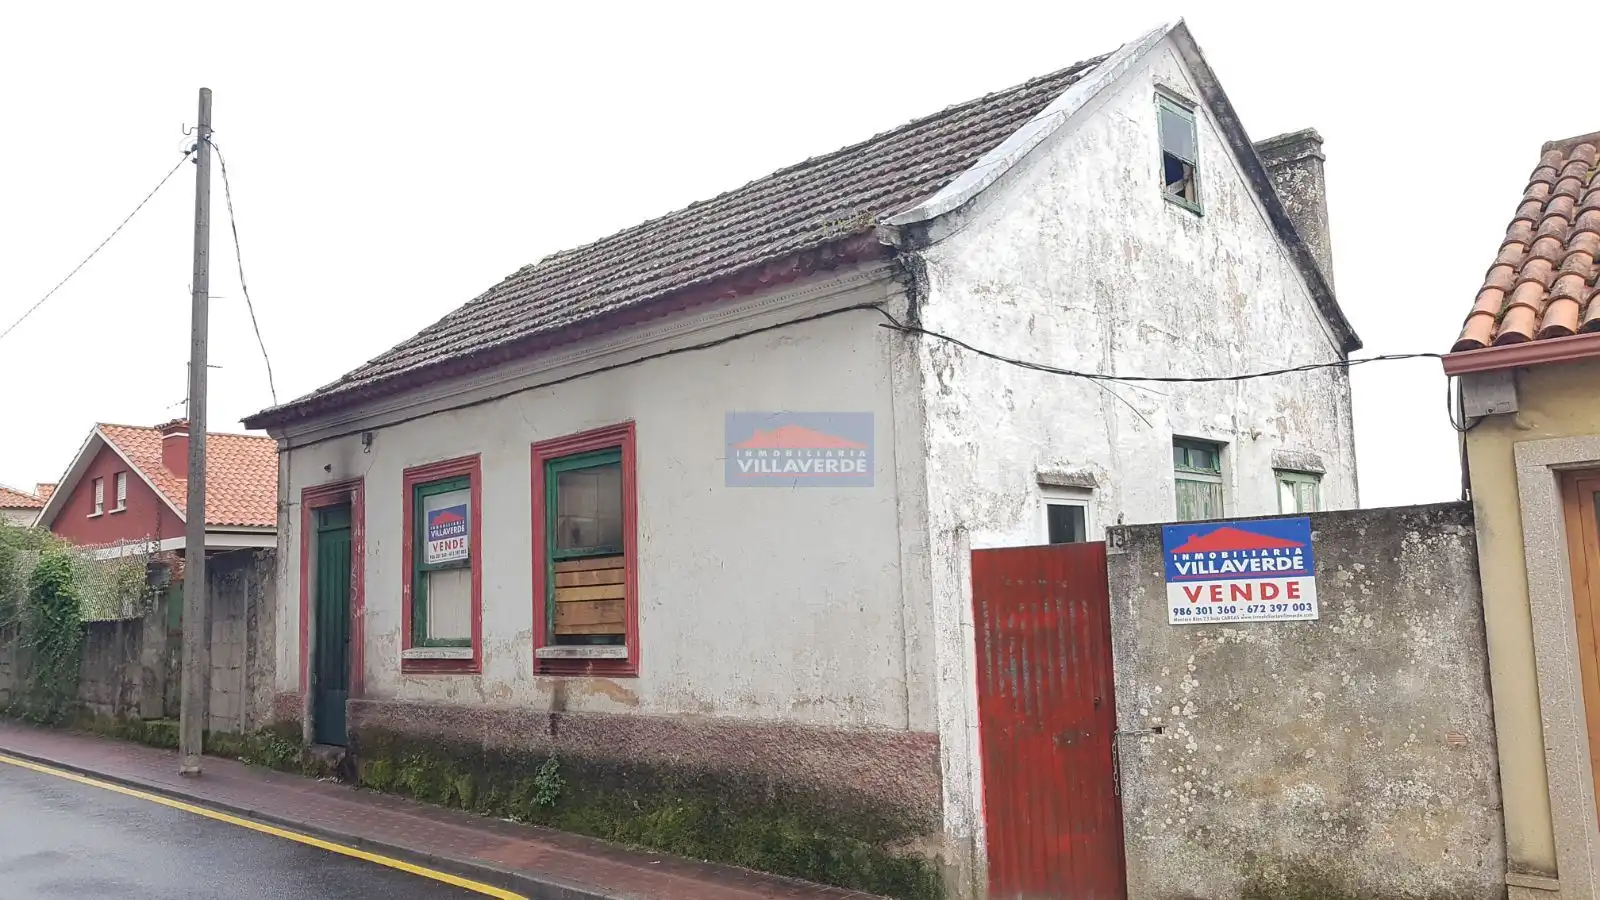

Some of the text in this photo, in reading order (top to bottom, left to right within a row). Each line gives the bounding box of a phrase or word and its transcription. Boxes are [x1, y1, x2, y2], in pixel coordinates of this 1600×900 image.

[430, 525, 465, 538] VILLAVERDE
[432, 538, 464, 552] VENDE
[1173, 548, 1303, 561] INMOBILIARIA
[1174, 556, 1304, 575] VILLAVERDE
[1182, 581, 1301, 603] VENDE
[1173, 607, 1192, 616] 986
[1195, 606, 1213, 615] 301
[1217, 605, 1236, 614] 360
[1247, 604, 1266, 613] 672
[1269, 603, 1288, 612] 397
[1292, 602, 1312, 611] 003
